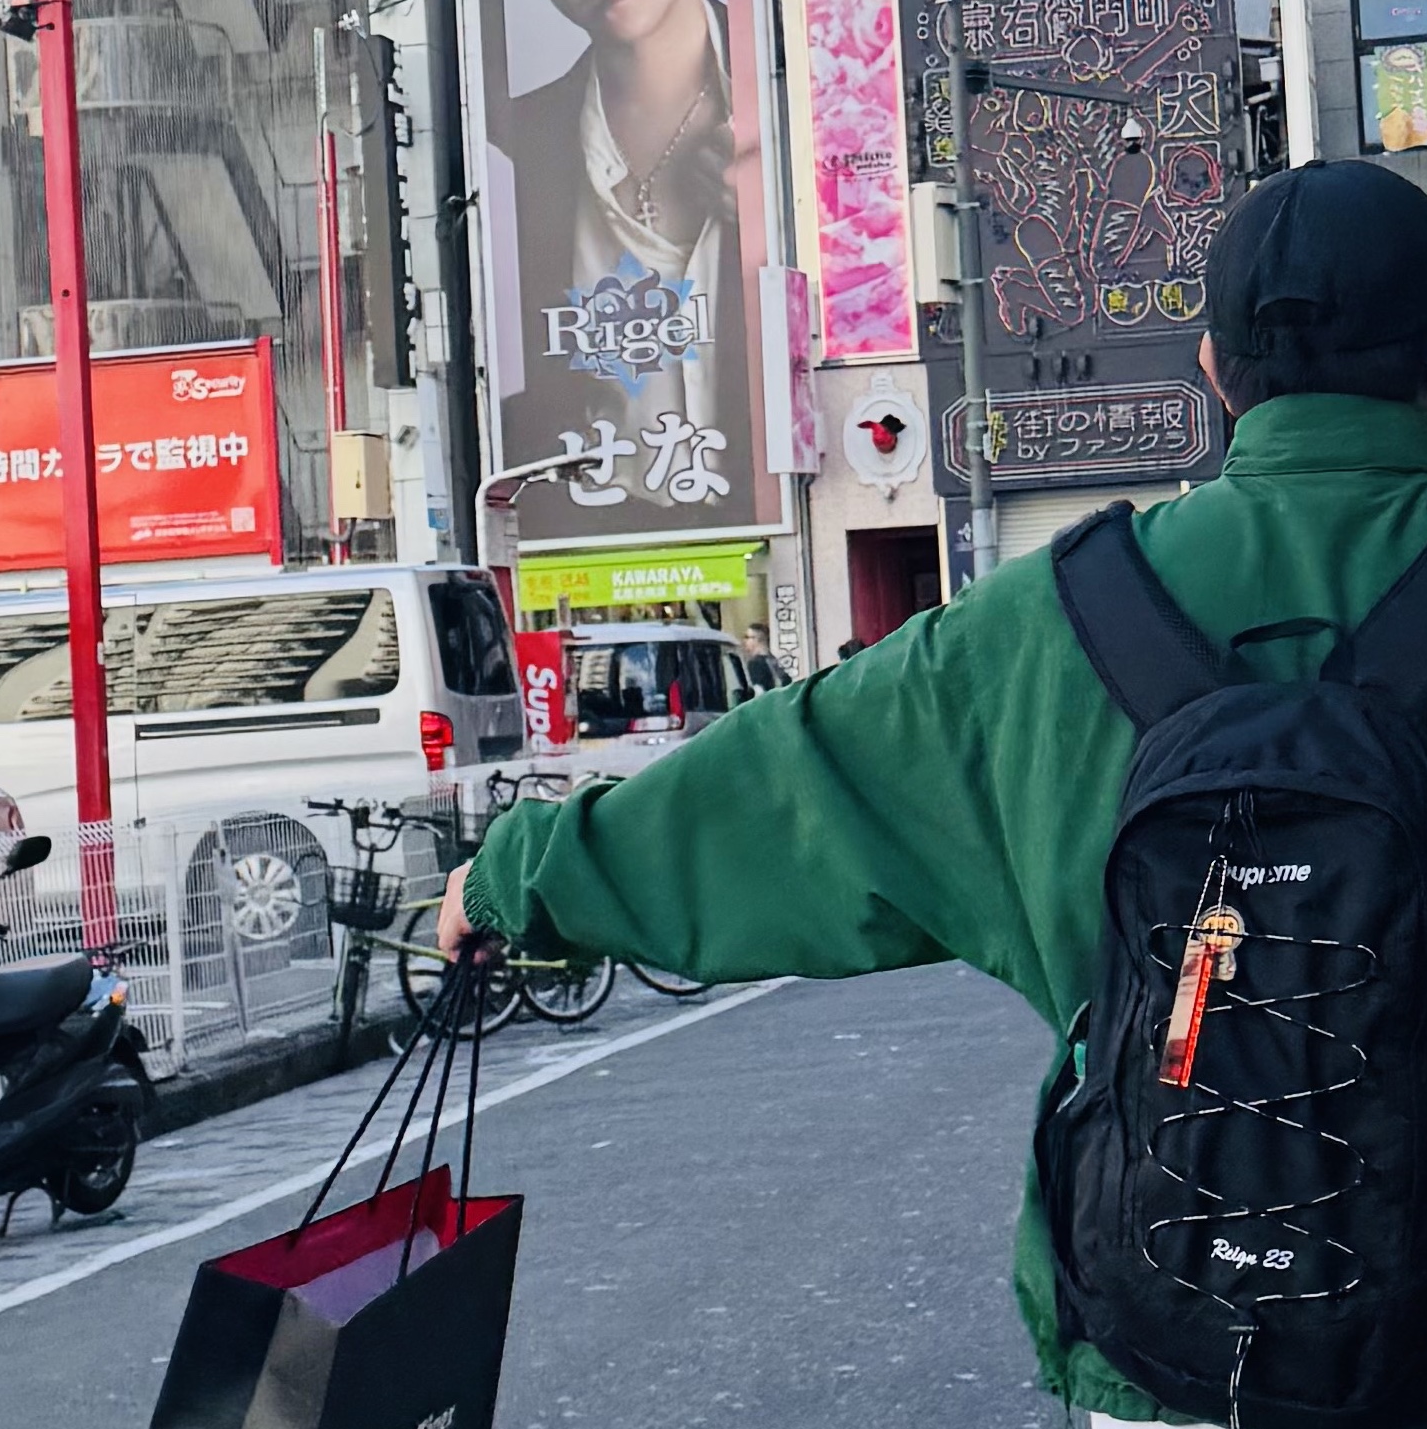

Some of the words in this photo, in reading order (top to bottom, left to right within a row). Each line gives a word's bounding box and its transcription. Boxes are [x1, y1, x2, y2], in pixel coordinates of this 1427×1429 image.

[540, 293, 716, 365] Rigel
[1013, 399, 1185, 439] 街の情報
[558, 412, 730, 508] せな
[1016, 441, 1049, 461] by
[1224, 863, 1312, 891] upreme
[1262, 1248, 1294, 1270] 23
